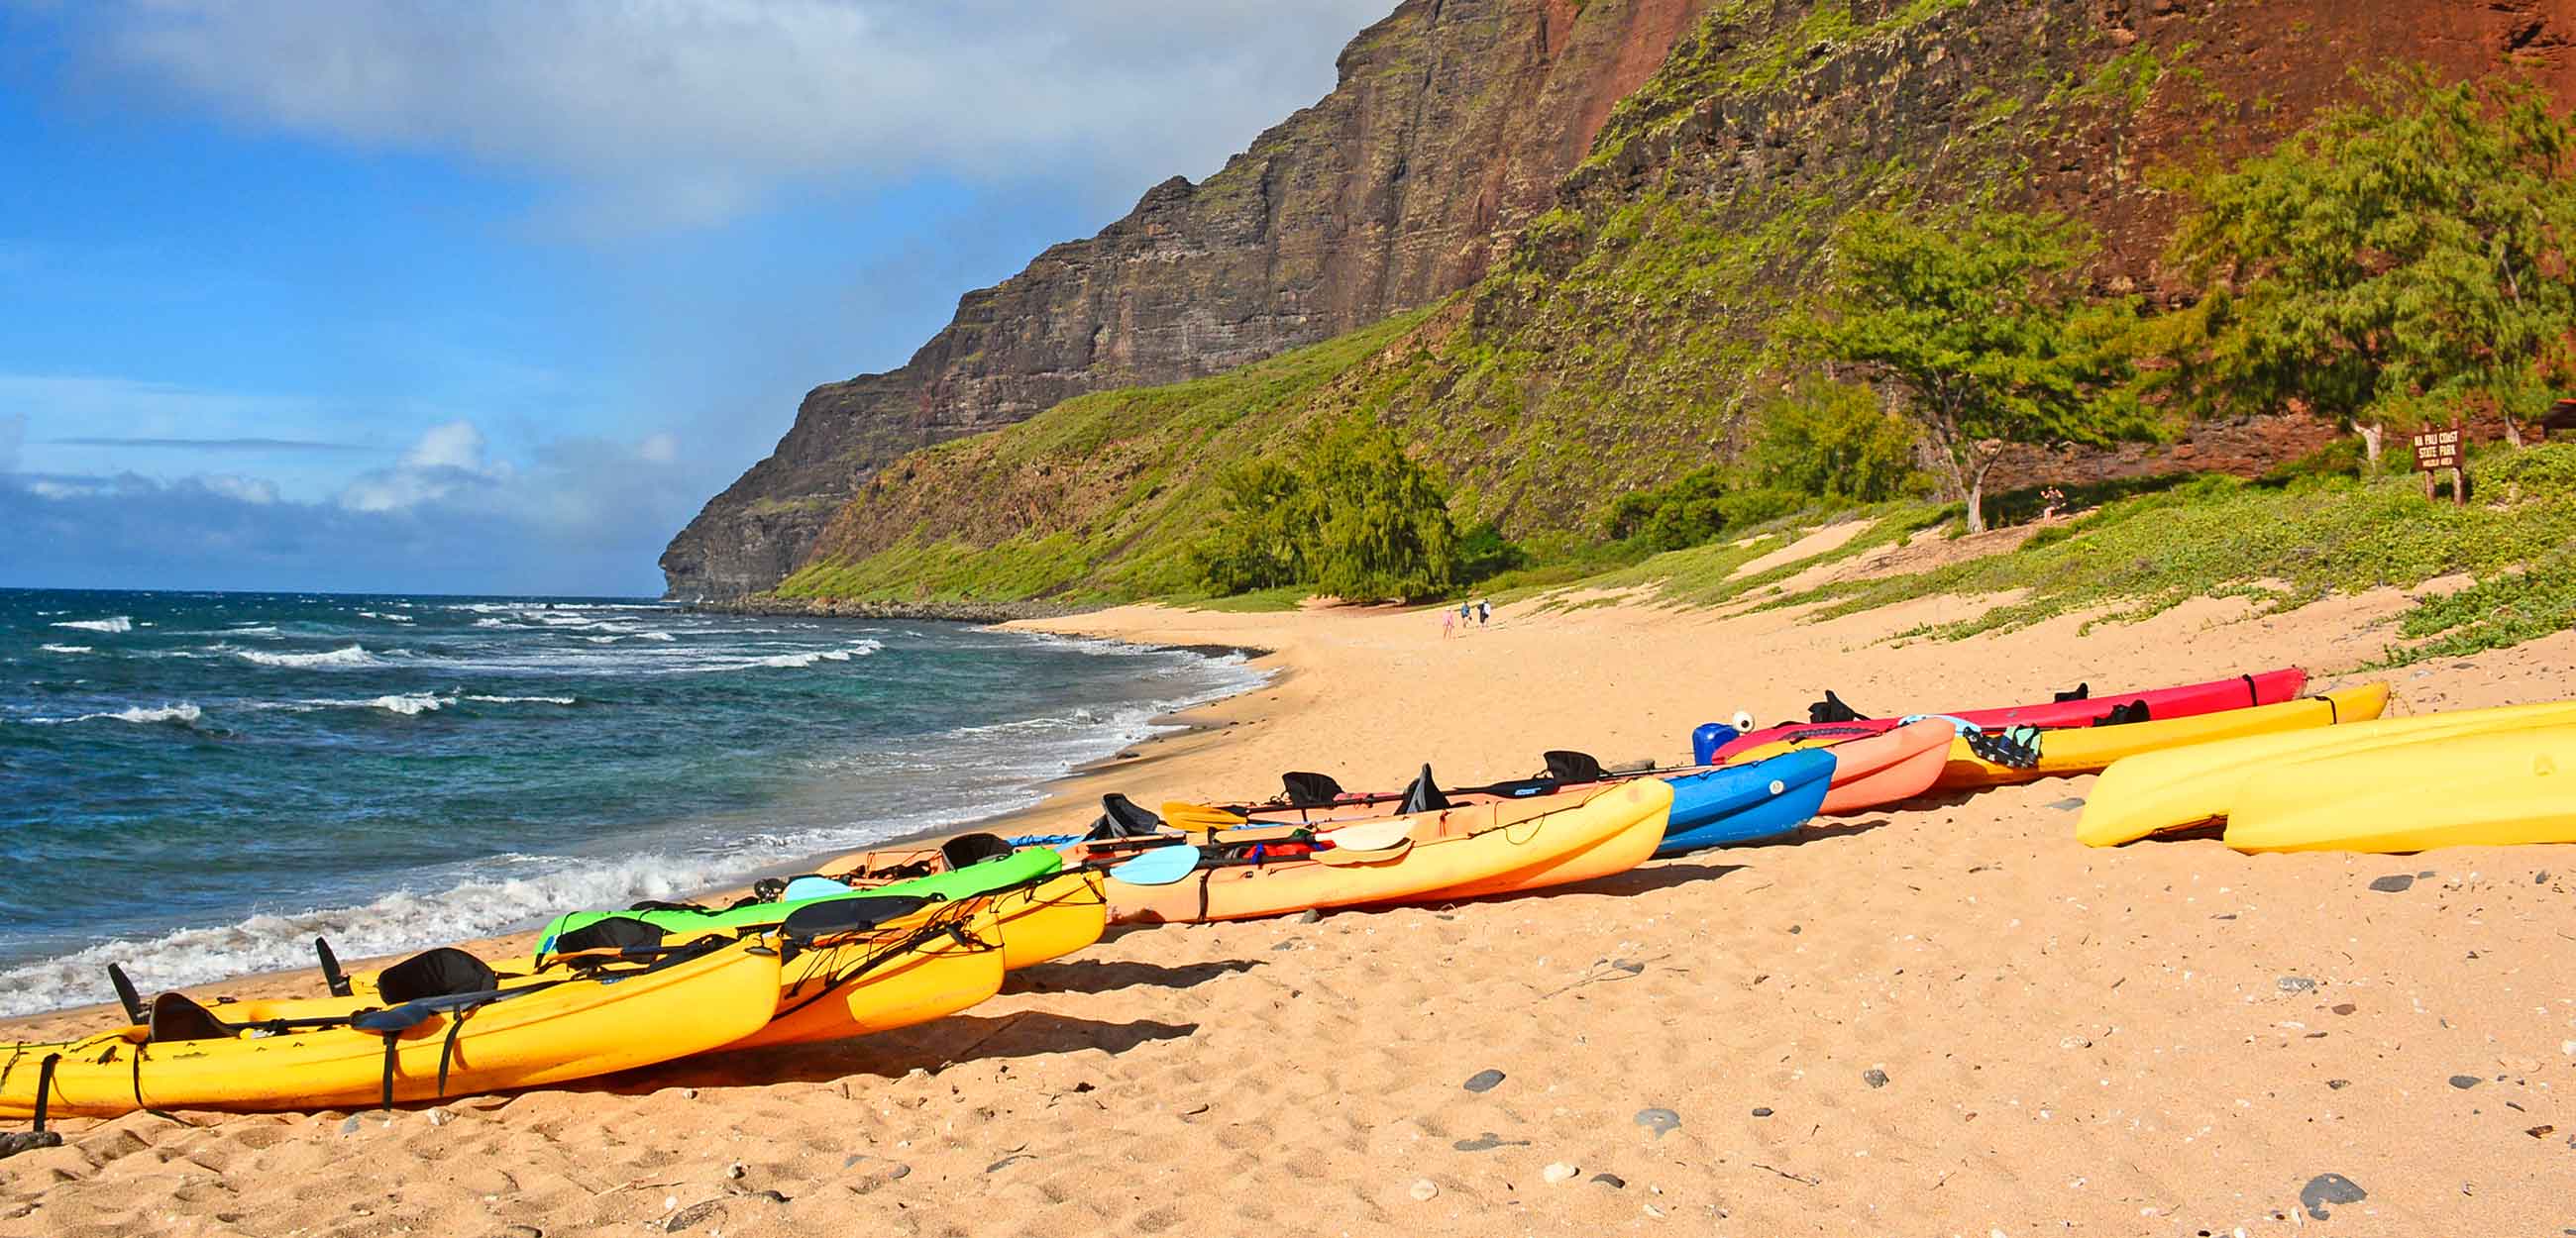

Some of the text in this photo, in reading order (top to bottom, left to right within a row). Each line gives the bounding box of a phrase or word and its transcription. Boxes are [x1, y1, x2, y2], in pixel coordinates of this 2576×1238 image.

[2439, 431, 2458, 444] COAST
[2418, 444, 2456, 459] STATE PARK
